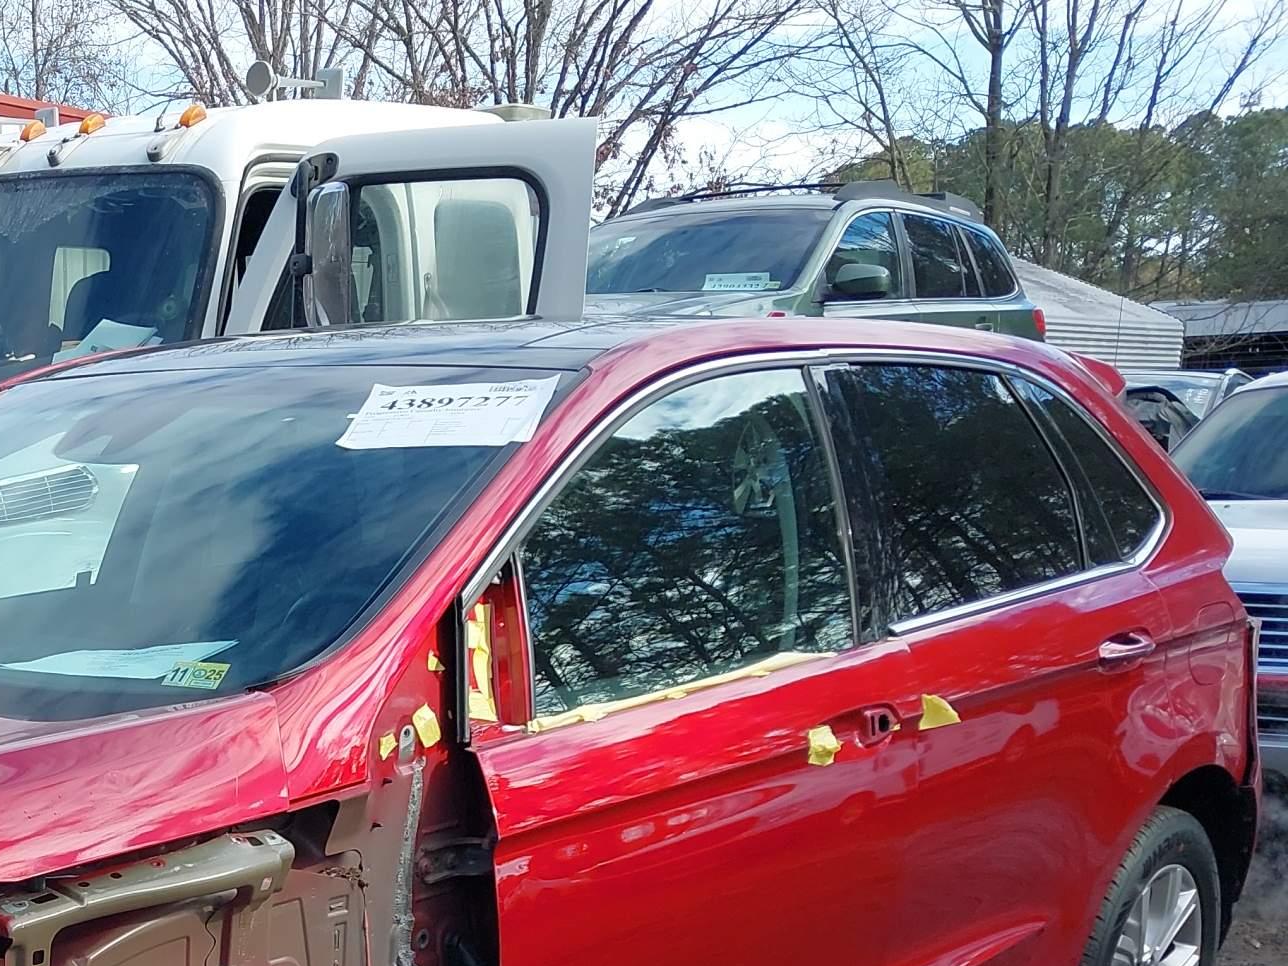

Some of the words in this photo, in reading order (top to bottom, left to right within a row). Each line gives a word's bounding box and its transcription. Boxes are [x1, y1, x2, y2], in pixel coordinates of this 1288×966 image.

[380, 395, 528, 410] 43897277
[170, 666, 190, 682] 11
[204, 668, 224, 681] 25
